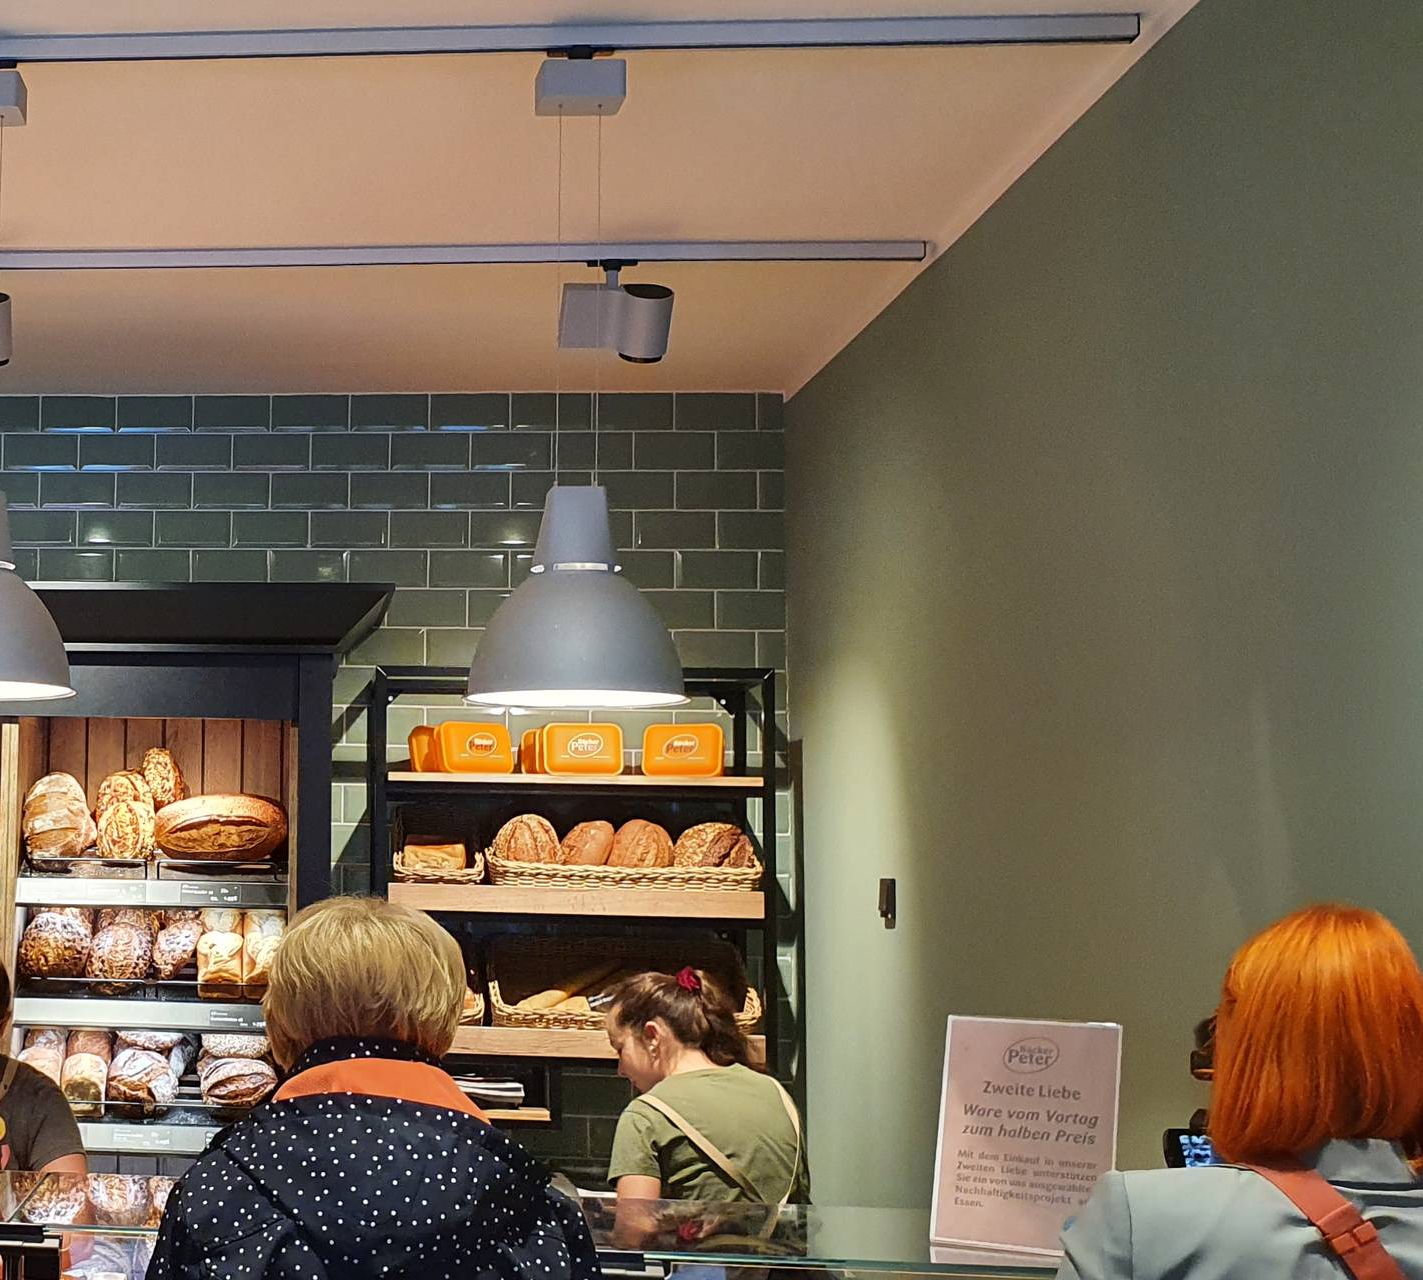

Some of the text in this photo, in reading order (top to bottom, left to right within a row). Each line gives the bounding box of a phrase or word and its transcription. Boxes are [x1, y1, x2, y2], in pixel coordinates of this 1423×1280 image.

[1008, 1049, 1053, 1066] Peter
[983, 1080, 1081, 1101] Zweite Liebe
[963, 1103, 1100, 1130] Ware vom Vortag
[962, 1123, 1097, 1145] zum halben Preis
[957, 1149, 1098, 1170] Mit dem Einkauf in unserer
[956, 1161, 1098, 1182] Zweiten Liebe unterstützen
[956, 1173, 1091, 1194] Sie ein von uns ausgewählte
[954, 1197, 984, 1208] Essen.
[955, 1185, 1072, 1204] Nachhaltigkeitsprojekt
